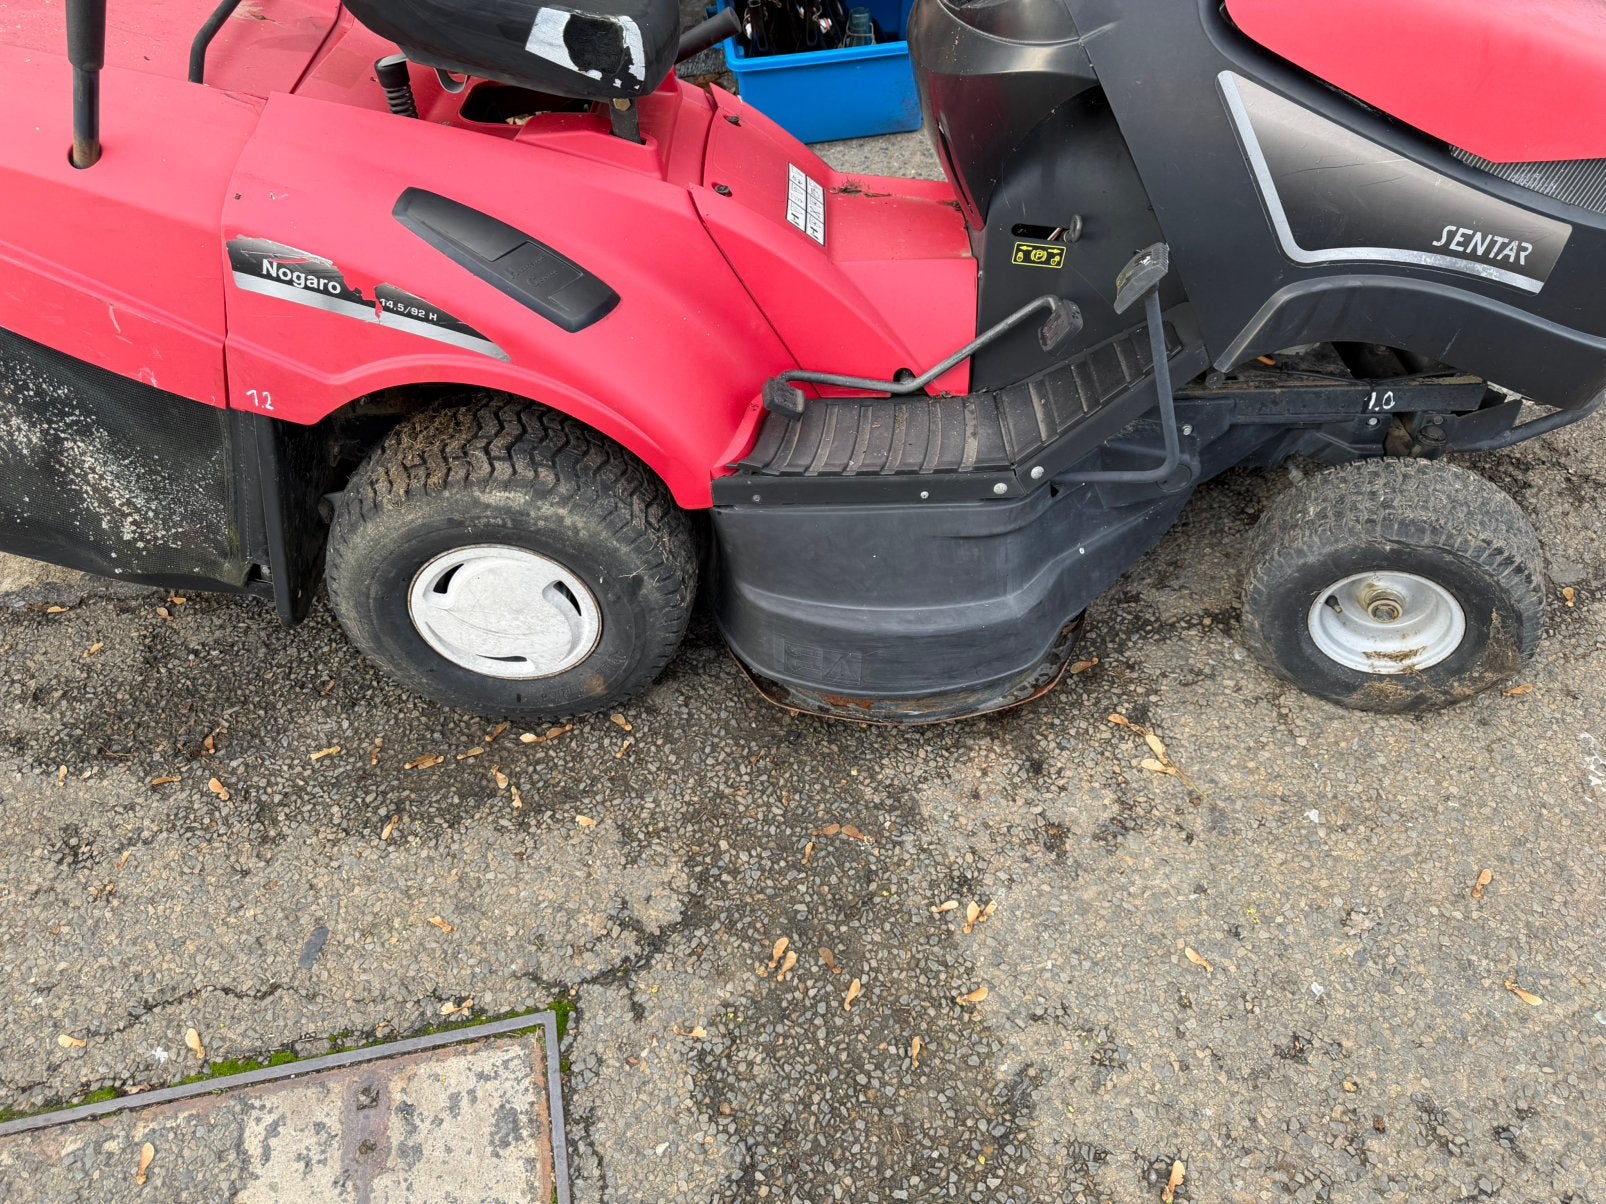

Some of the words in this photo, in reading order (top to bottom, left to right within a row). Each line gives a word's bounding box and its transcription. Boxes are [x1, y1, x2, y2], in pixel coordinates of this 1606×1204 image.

[1431, 225, 1533, 266] SENTAR
[261, 258, 342, 295] Nogaro
[379, 298, 426, 318] 14.5/92
[429, 312, 438, 321] H
